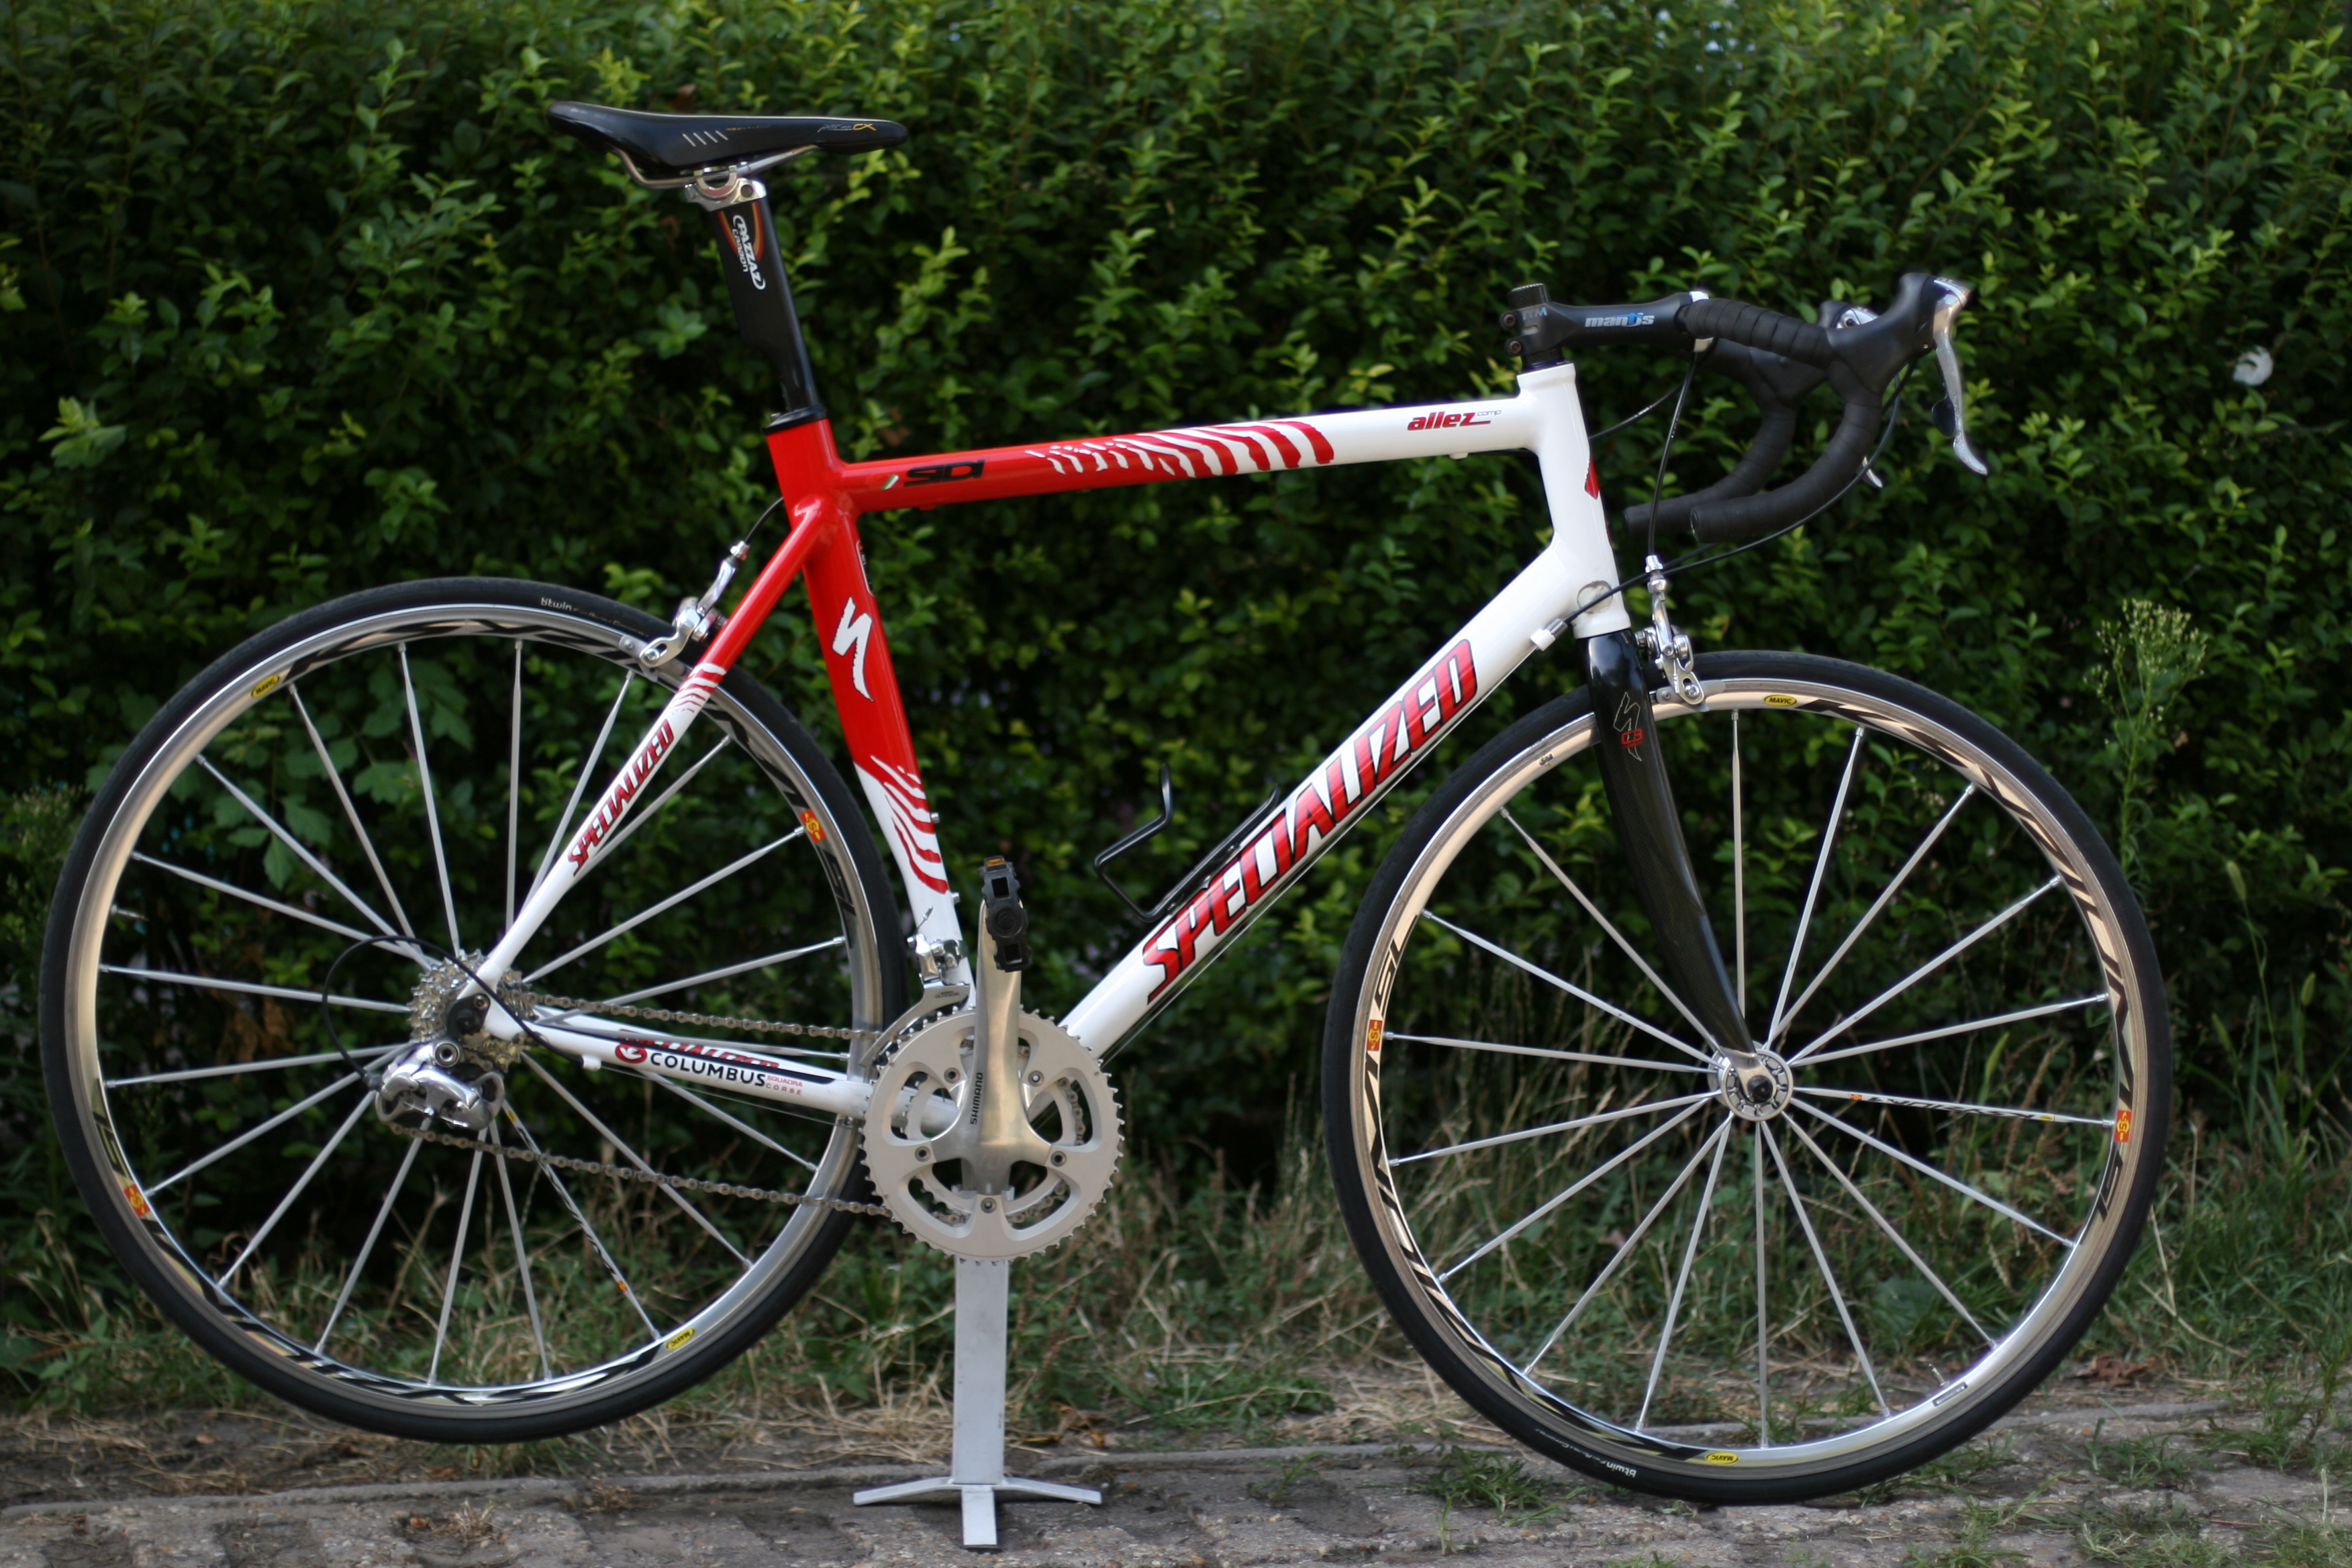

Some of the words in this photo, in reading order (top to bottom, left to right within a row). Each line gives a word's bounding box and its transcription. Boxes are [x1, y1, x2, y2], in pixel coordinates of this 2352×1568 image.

[732, 215, 766, 290] PAZZAZ
[1585, 312, 1655, 328] mantis
[1407, 411, 1491, 431] allez
[255, 678, 276, 695] MAVIC
[1769, 696, 1792, 705] MAVIC
[568, 719, 675, 877] SPECIALIZED
[1142, 639, 1477, 1005] SPECIALIZED
[650, 1052, 766, 1087] COLUMBUS
[767, 1075, 803, 1087] SQUADRA
[765, 1084, 802, 1095] CORSE
[970, 1072, 983, 1126] SHIMANO
[670, 1331, 691, 1348] MAVIC
[1710, 1454, 1734, 1463] MAVIC
